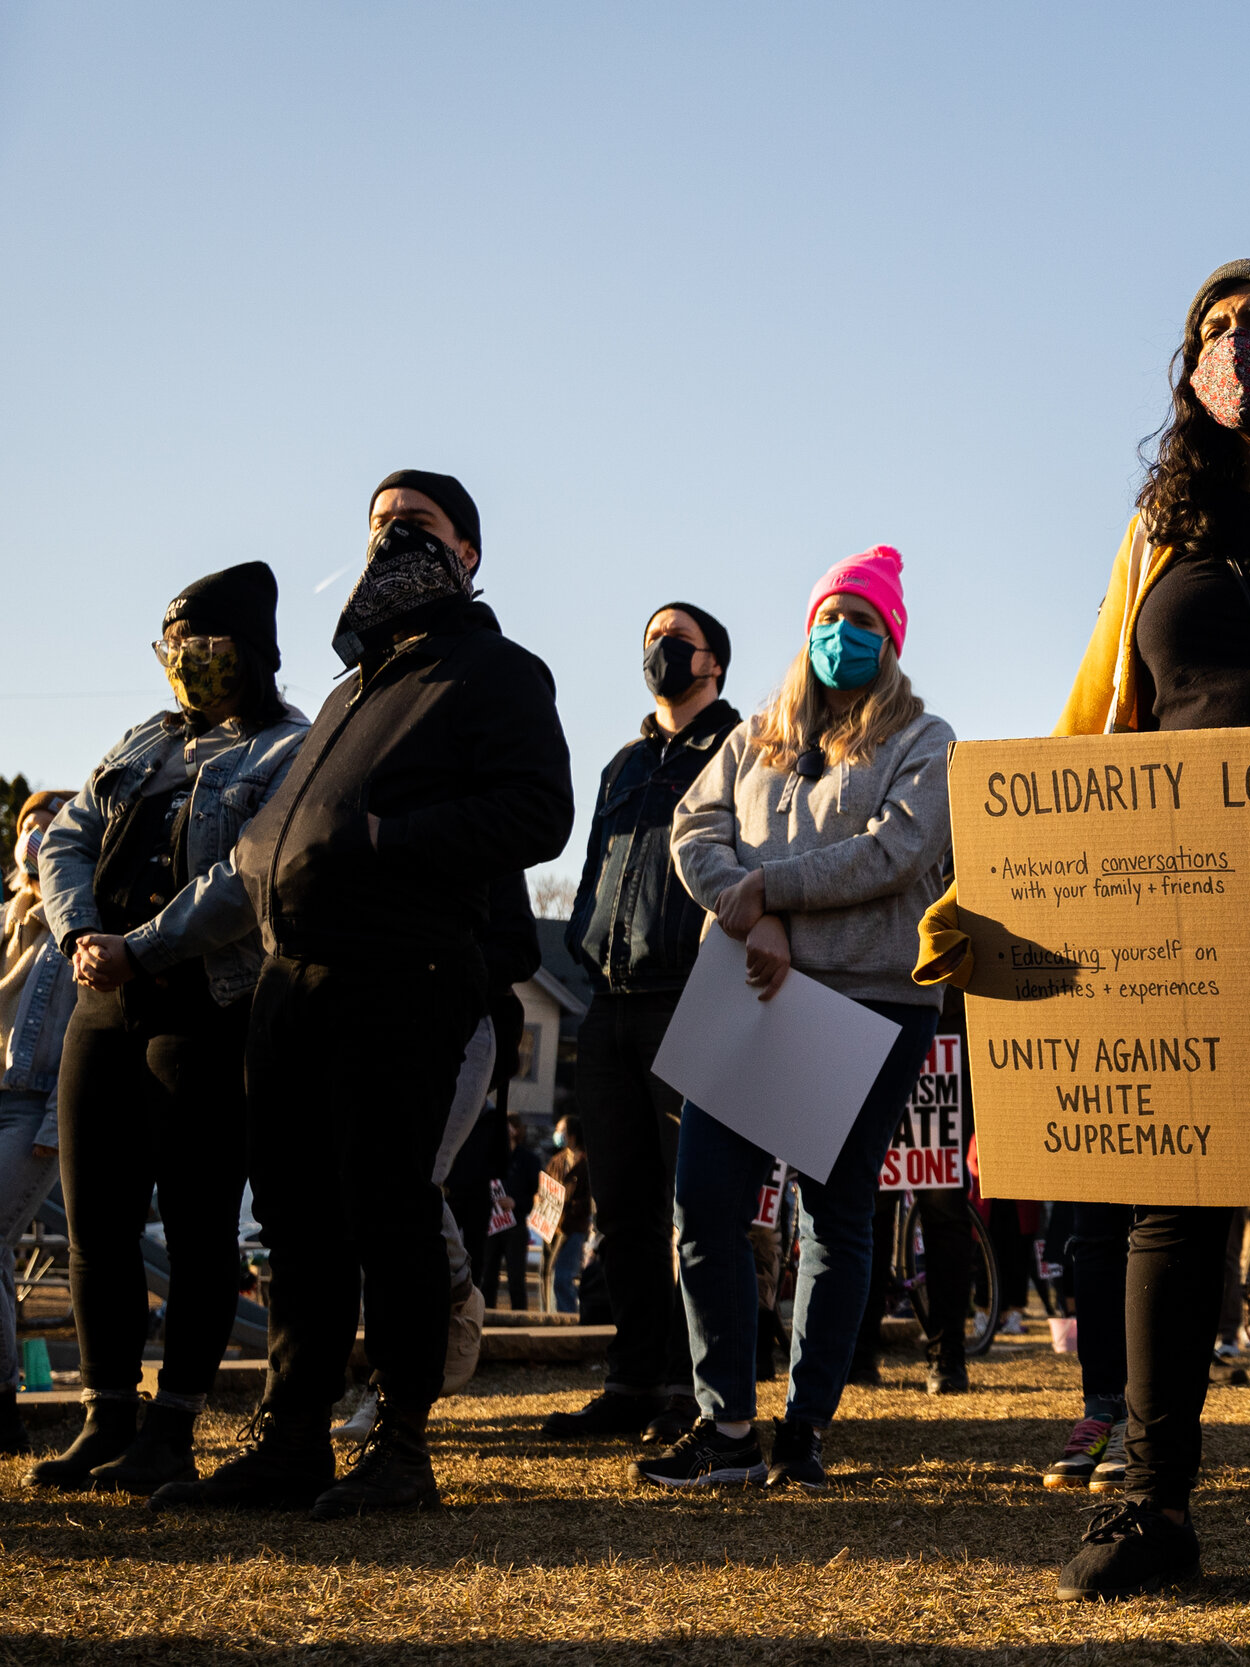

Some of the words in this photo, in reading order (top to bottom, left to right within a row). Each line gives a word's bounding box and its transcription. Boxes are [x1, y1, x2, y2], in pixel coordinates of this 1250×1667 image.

[984, 762, 1184, 817] SOLIDARITY
[1002, 851, 1089, 880] Awkward
[1101, 846, 1229, 873] conversations
[1011, 881, 1047, 900] with
[1054, 883, 1087, 908] your
[1093, 877, 1142, 905] family
[1162, 875, 1225, 896] friends
[1011, 942, 1100, 974] Educating
[1111, 939, 1182, 972] yourself
[1195, 945, 1217, 962] on
[1015, 979, 1095, 999] identities
[1119, 979, 1220, 1004] experiences
[988, 1038, 1080, 1073] UNITY
[1095, 1037, 1220, 1072] AGAINST
[1056, 1084, 1154, 1115] WHITE
[892, 1105, 959, 1148] ATE
[1043, 1121, 1211, 1156] SUPREMACY
[906, 1148, 960, 1185] ONE
